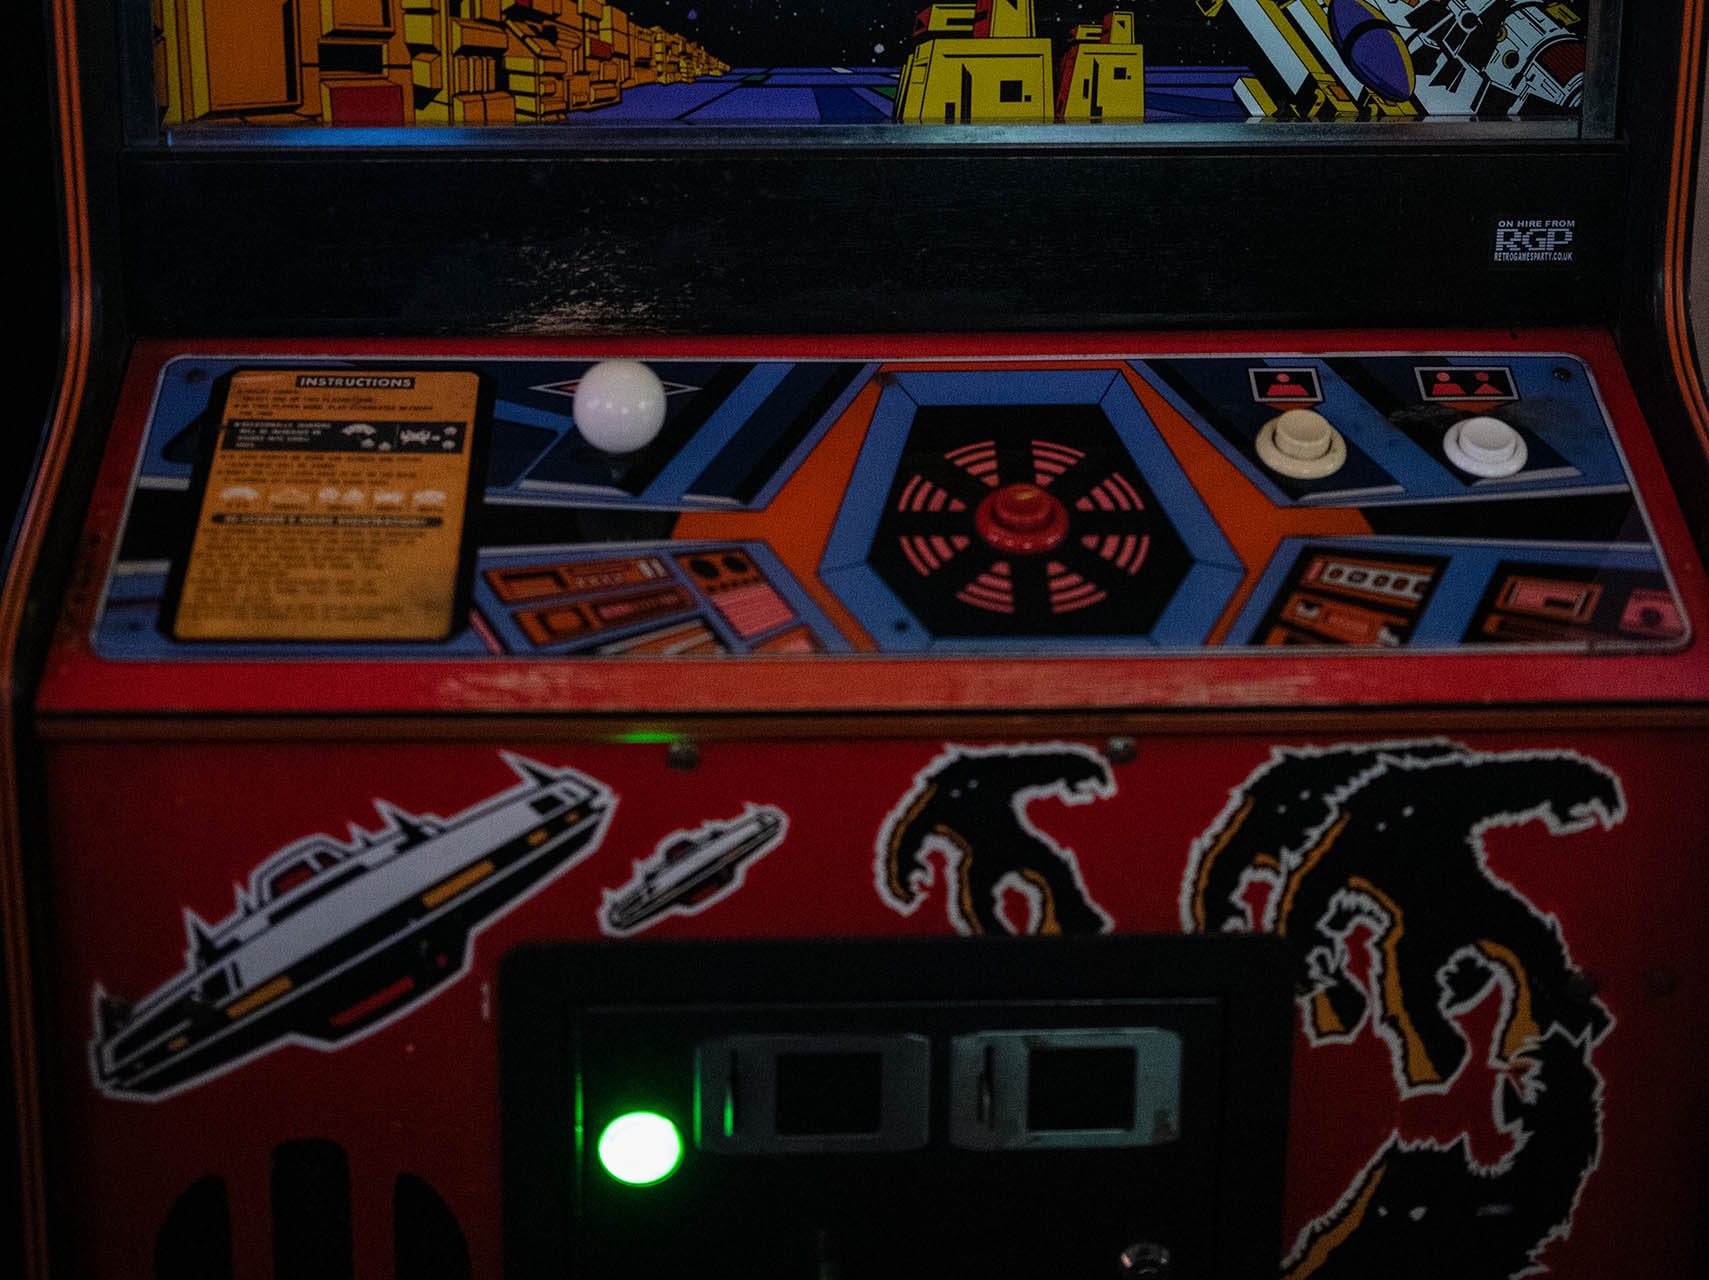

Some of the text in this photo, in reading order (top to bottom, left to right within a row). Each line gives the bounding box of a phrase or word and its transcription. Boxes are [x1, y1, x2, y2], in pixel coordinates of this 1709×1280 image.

[1498, 220, 1575, 228] ON HIRE FROM
[1495, 228, 1573, 251] RGP
[1494, 252, 1573, 262] RETROGAMESPARTY.CO.UK
[299, 376, 413, 389] INSTRUCTIONS
